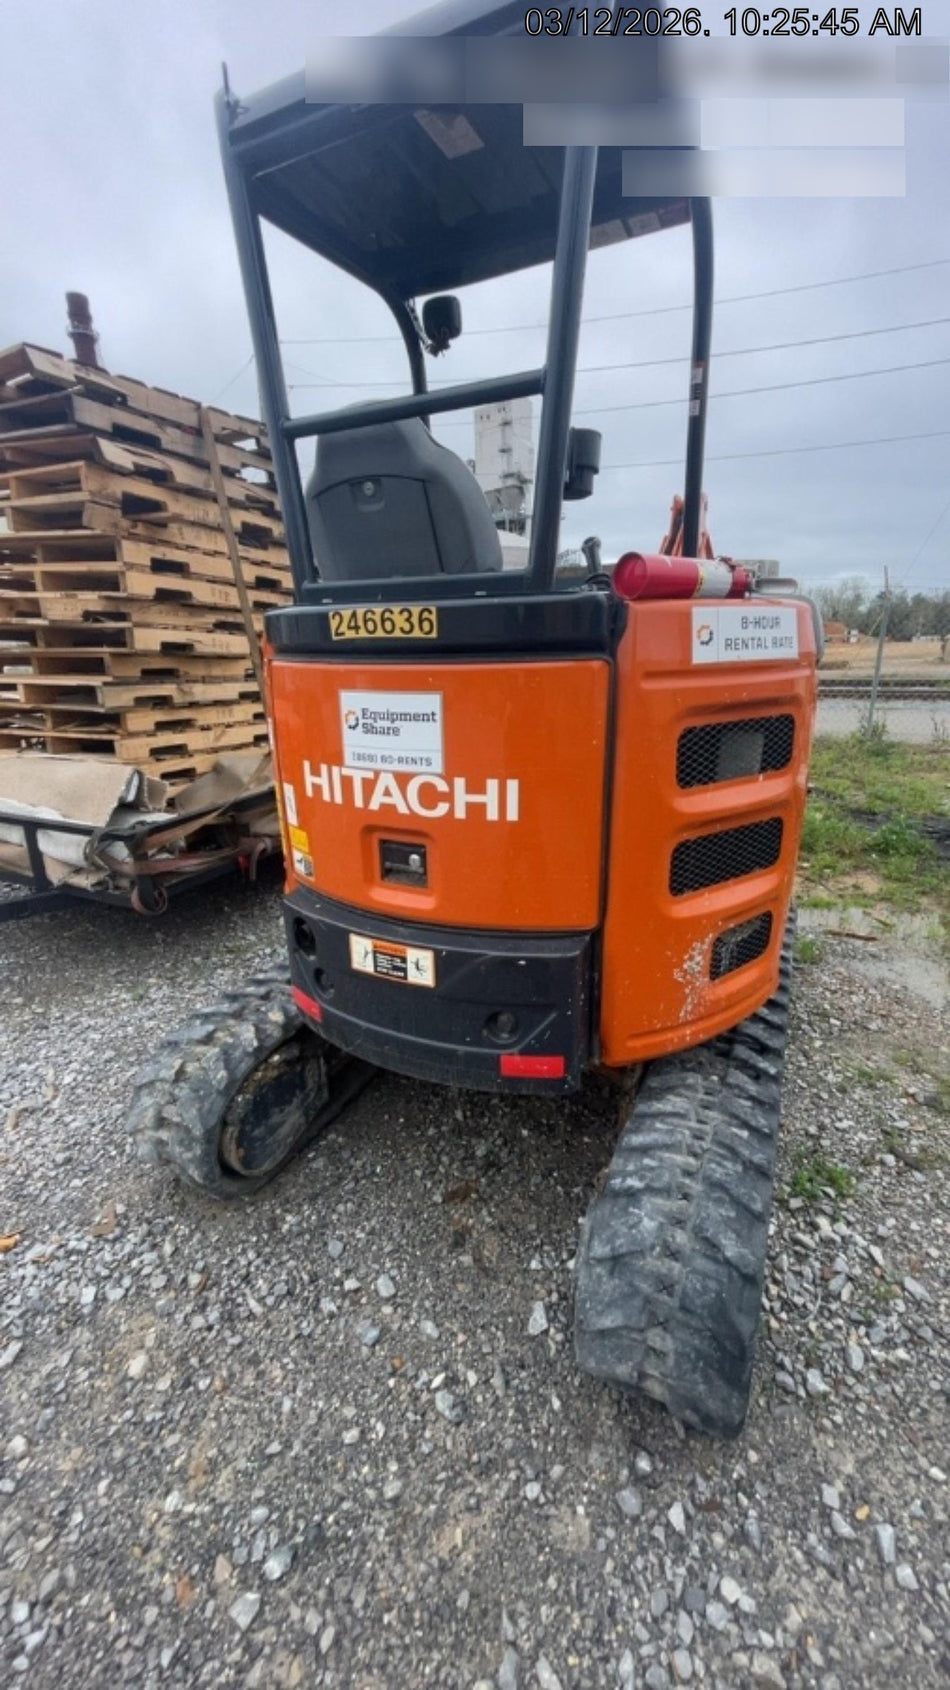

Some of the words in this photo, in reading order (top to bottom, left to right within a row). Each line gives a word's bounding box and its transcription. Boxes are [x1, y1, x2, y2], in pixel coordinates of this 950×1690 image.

[331, 607, 435, 637] 246636
[724, 637, 769, 651] RENTAL
[771, 636, 794, 649] RATE
[361, 707, 437, 724] Equipment
[361, 722, 401, 736] Share
[303, 760, 519, 821] HITACHI
